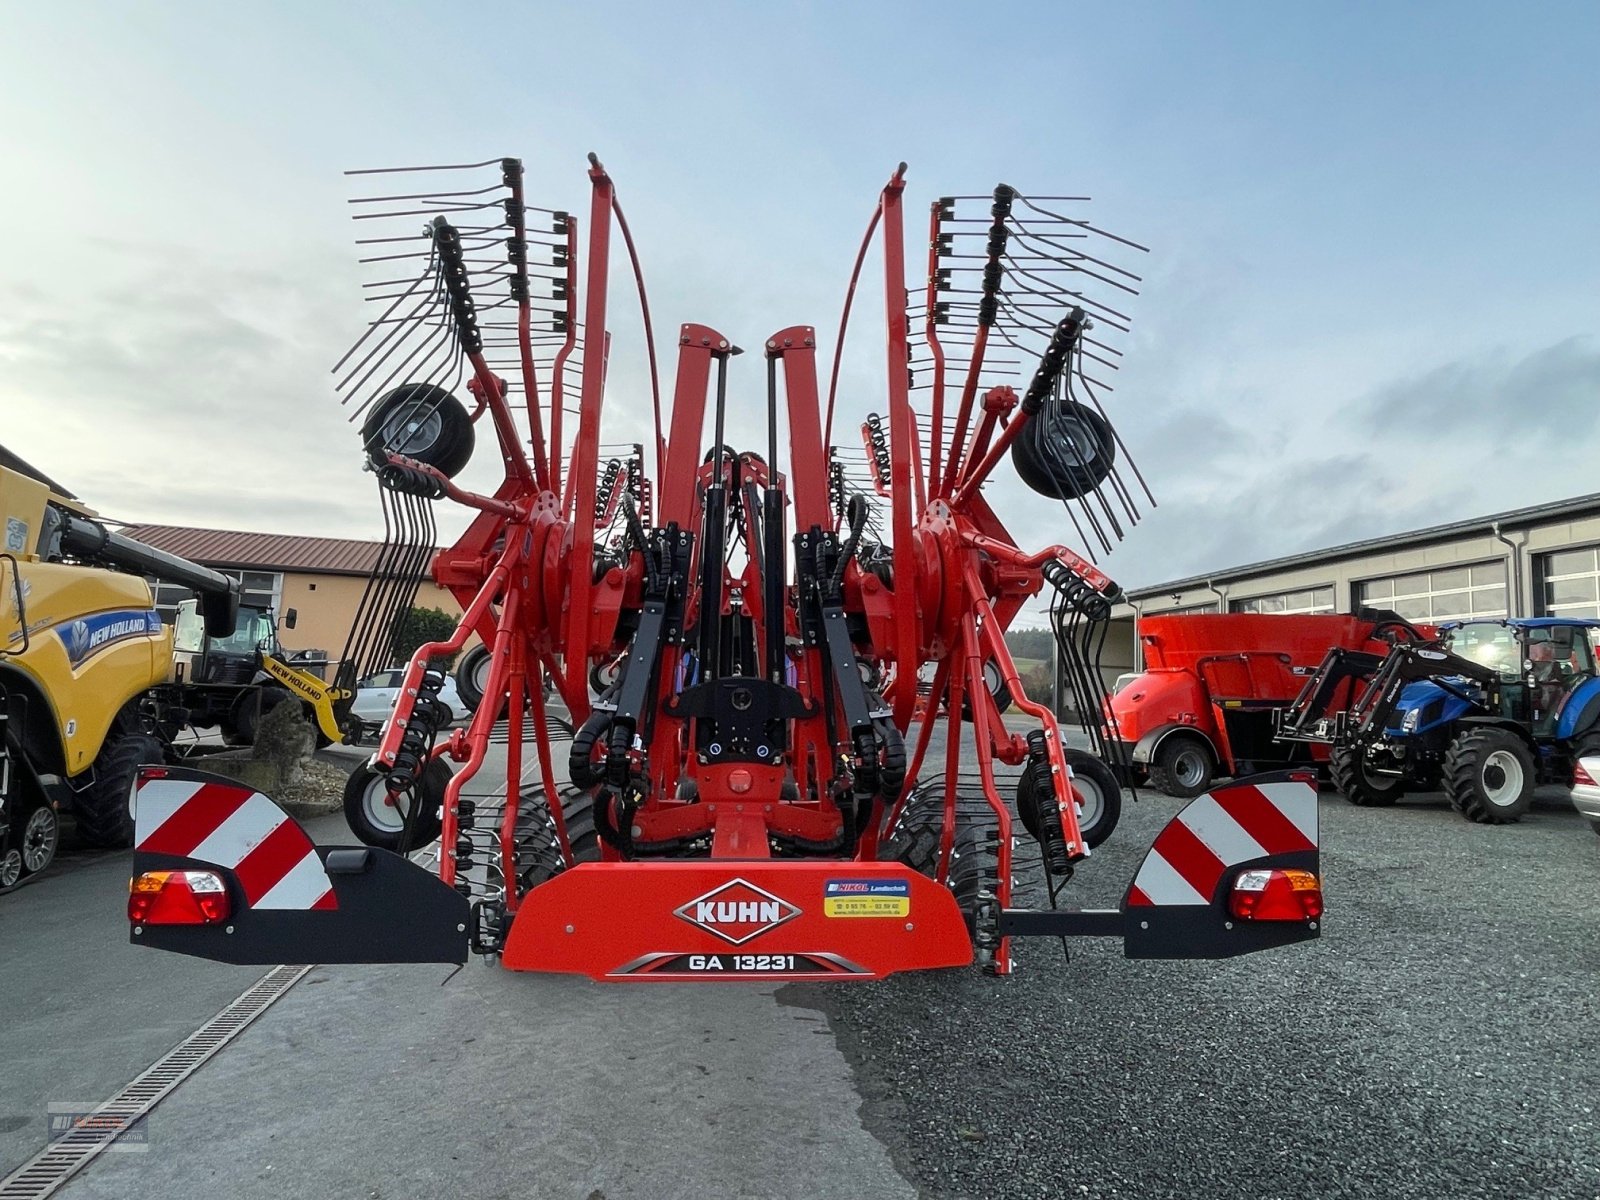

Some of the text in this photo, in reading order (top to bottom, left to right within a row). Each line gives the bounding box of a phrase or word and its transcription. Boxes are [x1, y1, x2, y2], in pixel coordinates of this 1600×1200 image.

[89, 618, 145, 649] NEW HOLLAND
[271, 664, 322, 700] NEW HOLLAND
[839, 883, 869, 892] NIKOL
[696, 901, 780, 923] KUHN
[689, 955, 794, 970] GA 13231
